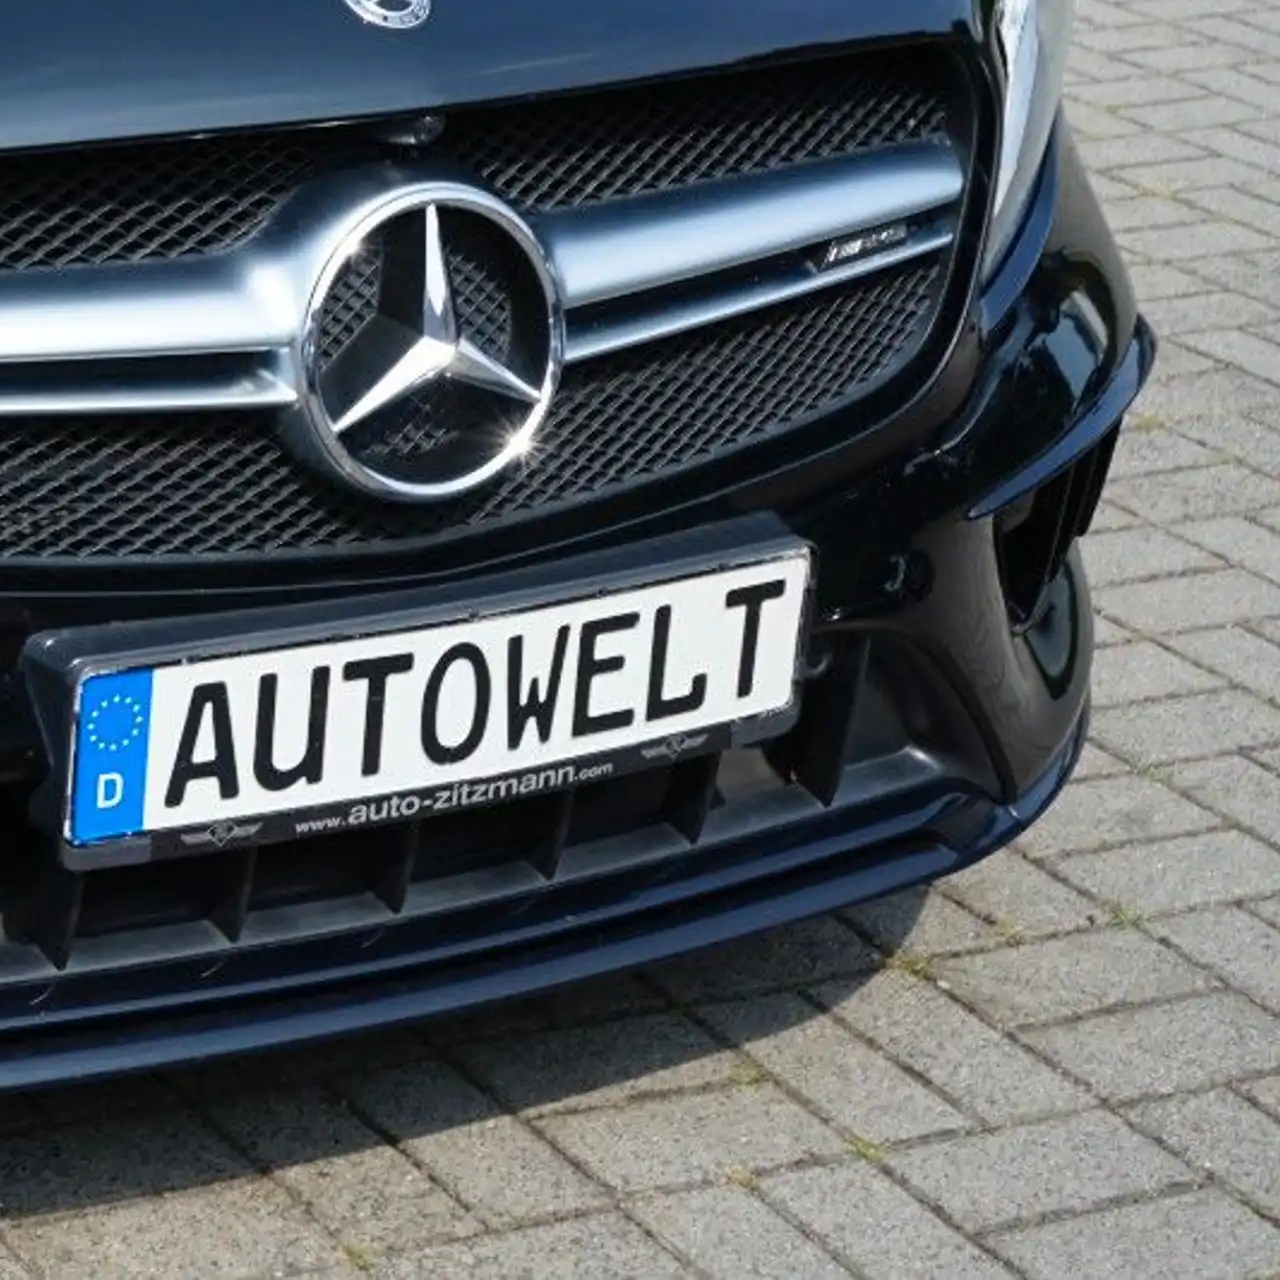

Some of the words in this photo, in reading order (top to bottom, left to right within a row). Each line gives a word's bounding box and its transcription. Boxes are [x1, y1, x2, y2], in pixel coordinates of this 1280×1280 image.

[96, 771, 124, 809] D
[165, 579, 786, 808] AUTOWELT
[295, 762, 614, 834] www.auto-zitzmann.com
